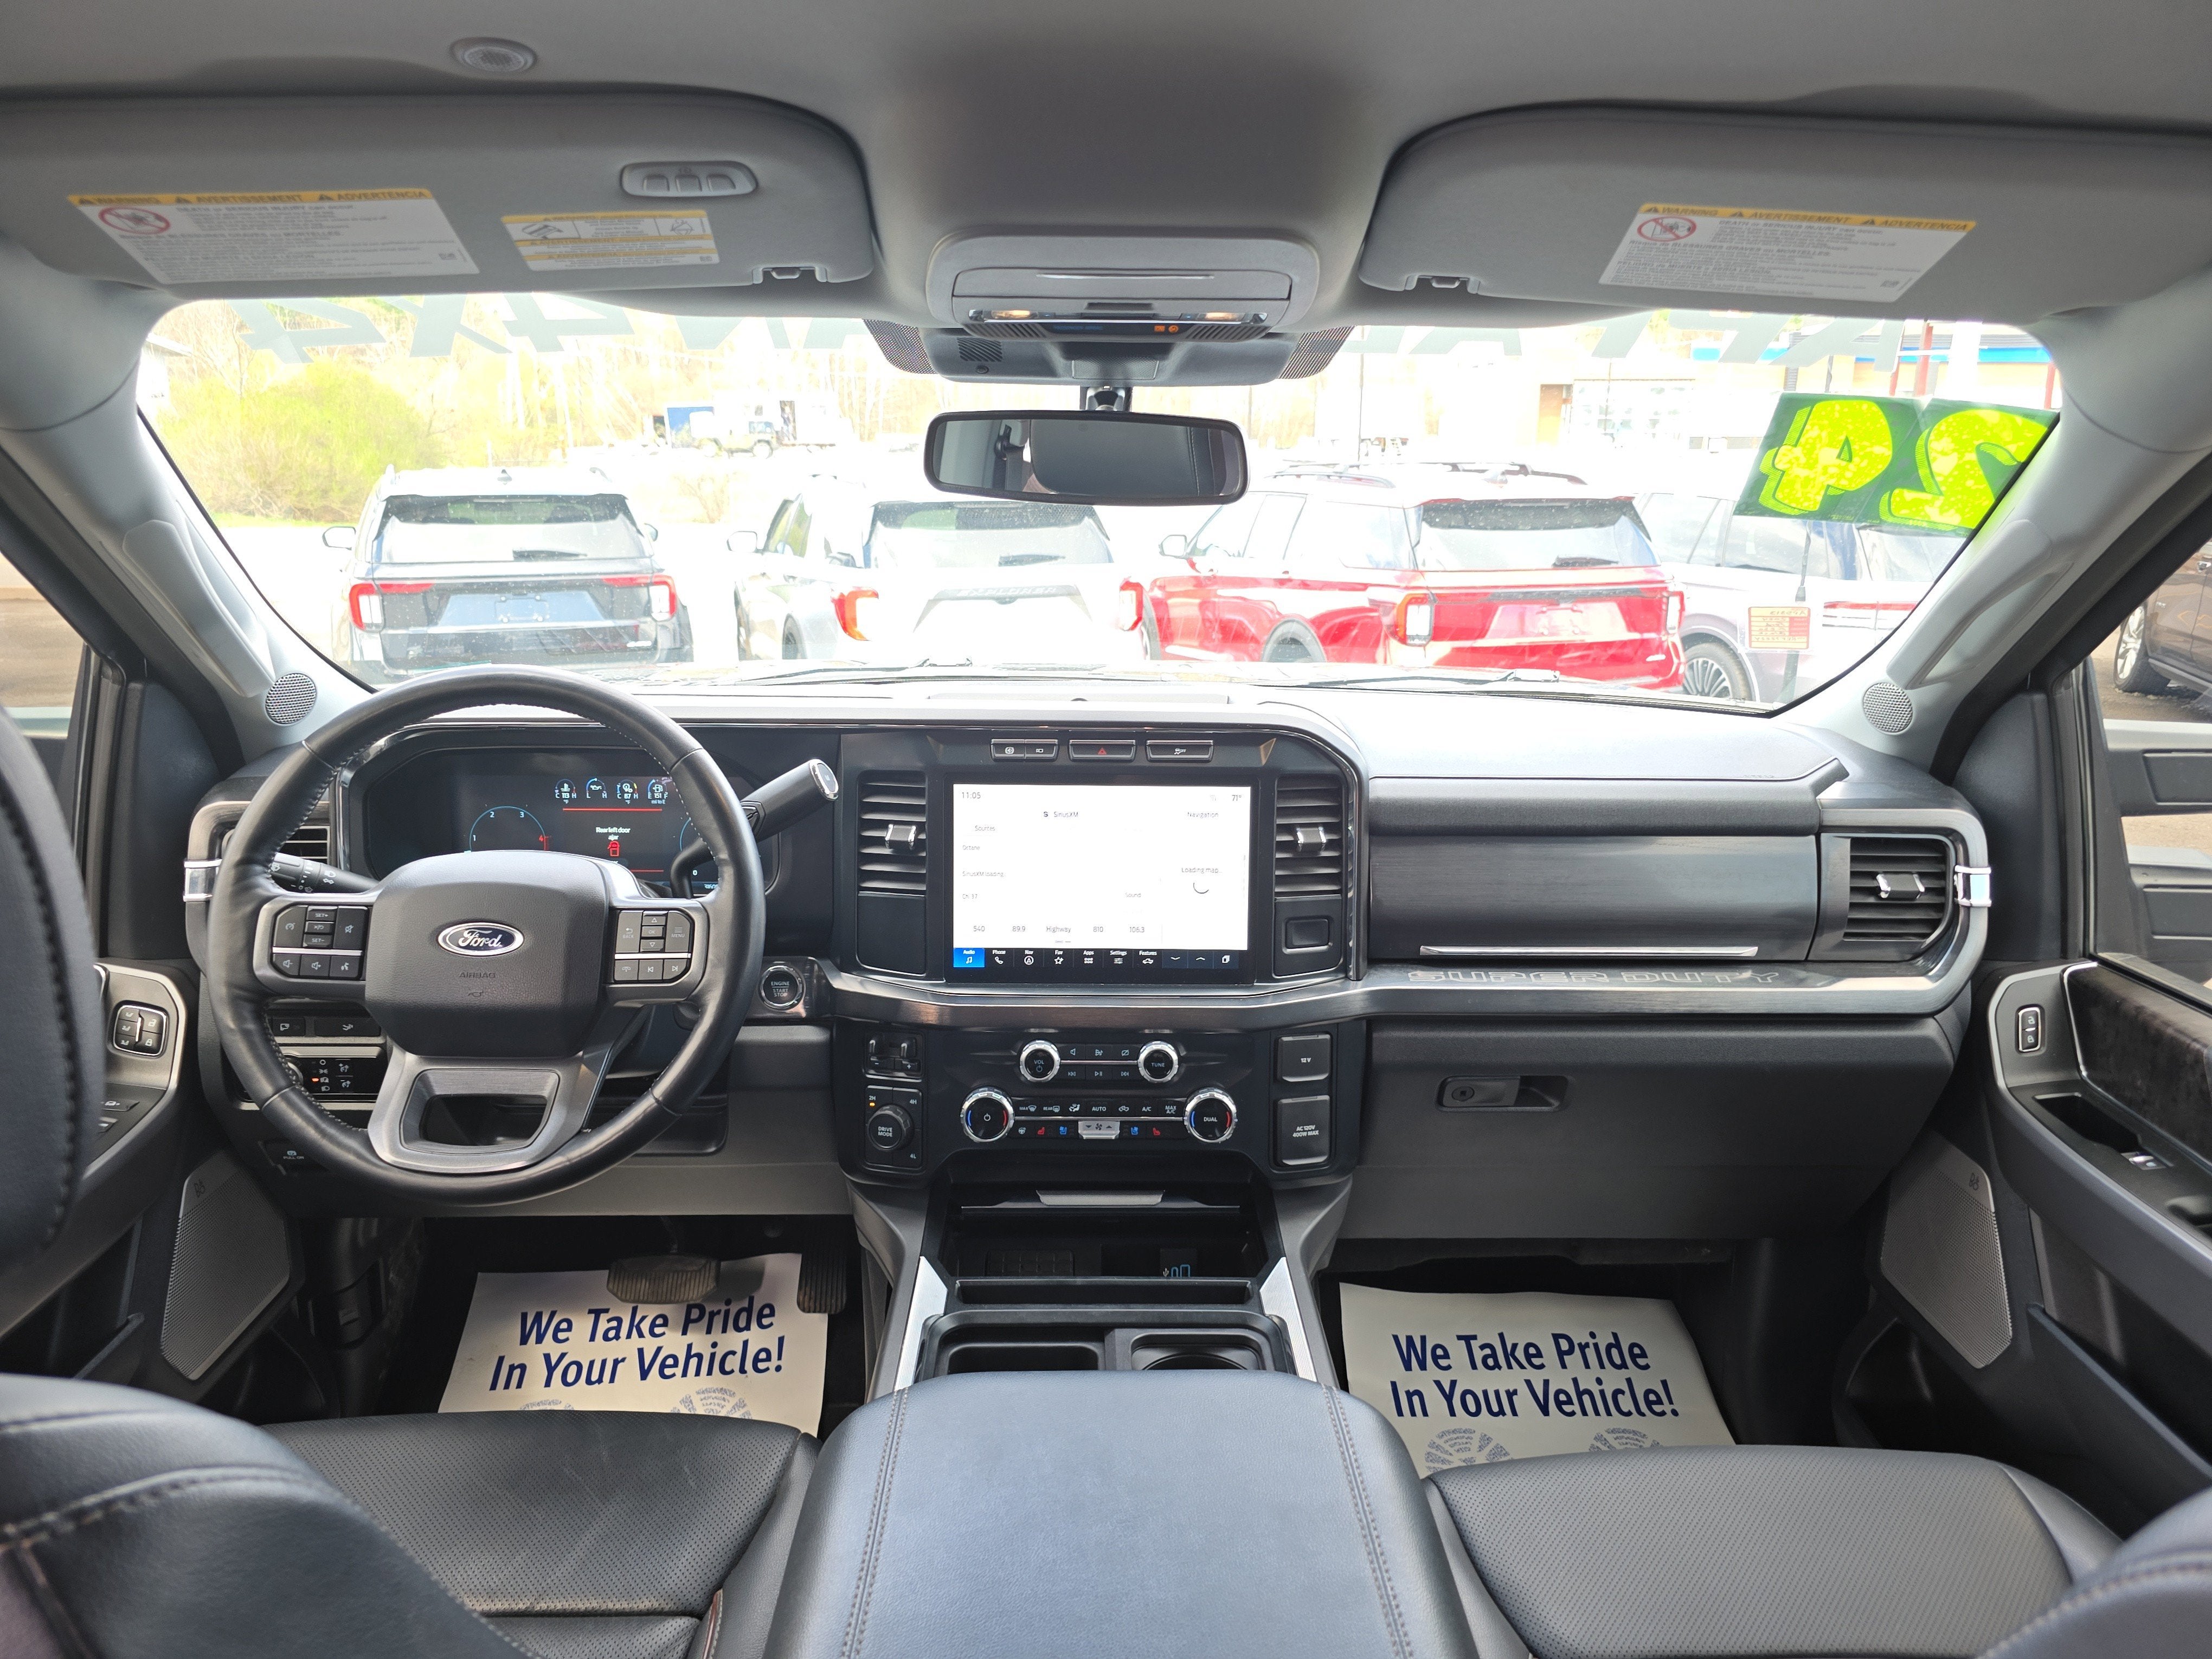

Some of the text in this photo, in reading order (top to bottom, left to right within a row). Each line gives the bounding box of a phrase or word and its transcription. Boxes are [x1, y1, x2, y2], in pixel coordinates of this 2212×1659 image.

[337, 191, 425, 200] ADVERTENCIA
[1662, 207, 1967, 232] WARNING AVERTISSEMENT ADVERTENCIA
[458, 929, 503, 947] Ford
[1408, 971, 1780, 983] SUPER DUTY
[519, 1296, 776, 1346] We Take Pride
[489, 1335, 786, 1391] In Your Vehicle!
[1391, 1330, 1651, 1372] We Take Pride
[1390, 1377, 1680, 1418] In Your Vehicle!
